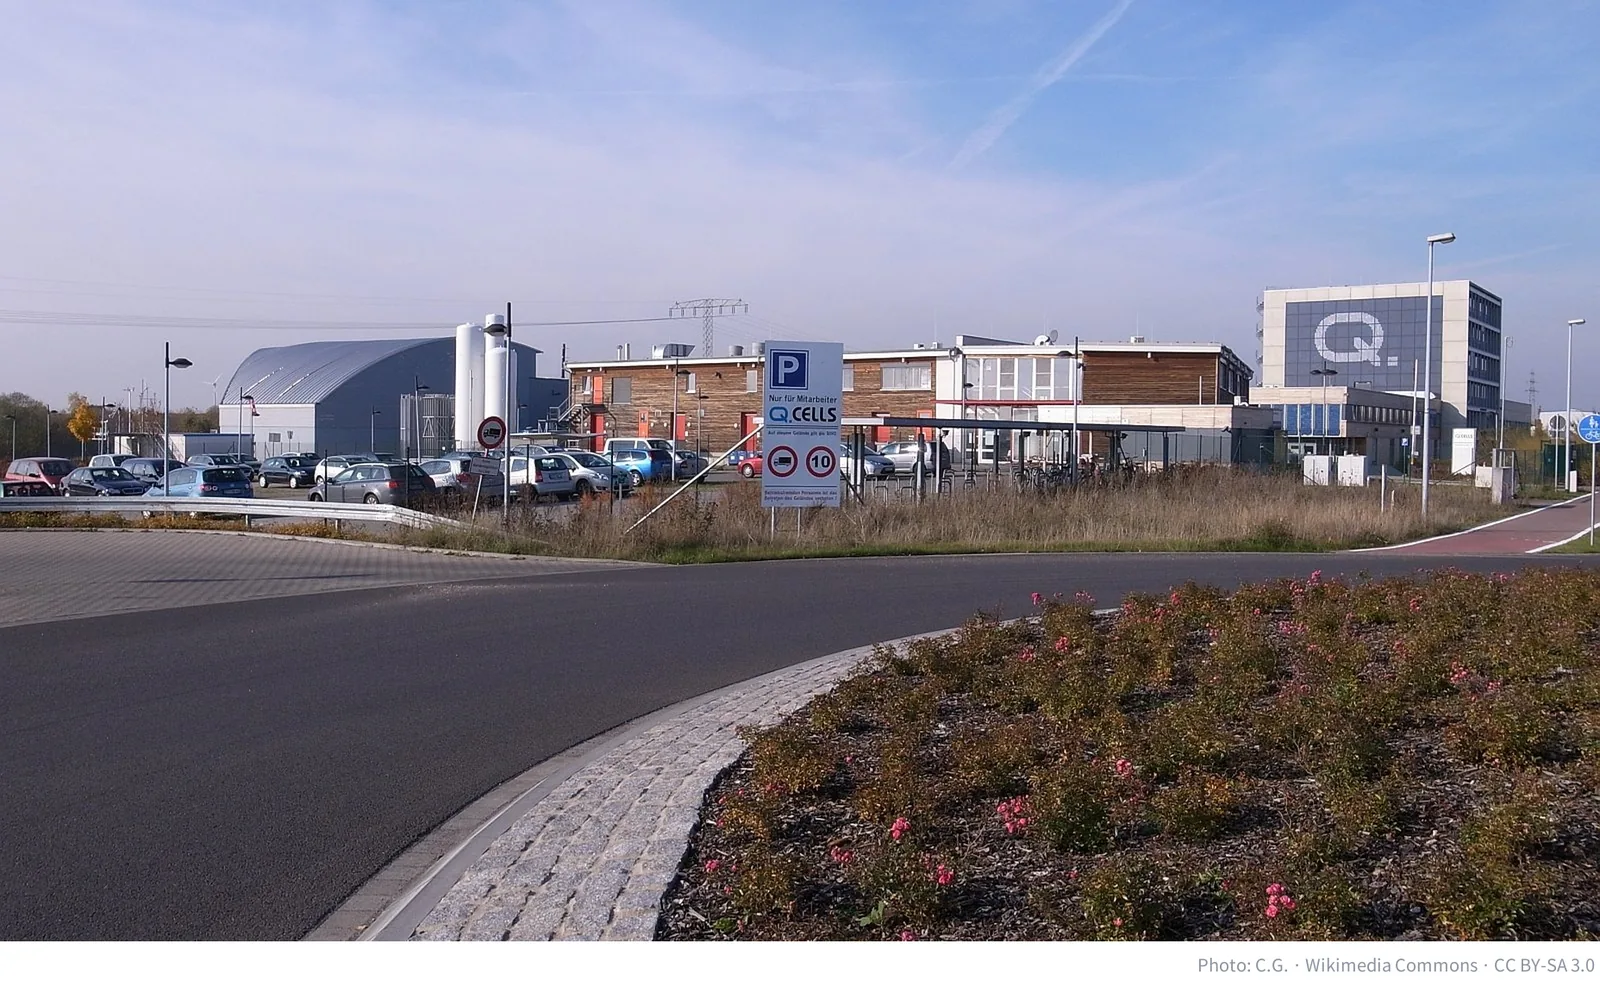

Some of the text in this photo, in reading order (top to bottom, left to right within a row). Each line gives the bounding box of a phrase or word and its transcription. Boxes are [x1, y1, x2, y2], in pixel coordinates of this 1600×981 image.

[778, 355, 800, 384] P
[769, 394, 837, 404] Nur für Mitarbeiter
[811, 454, 831, 468] 10
